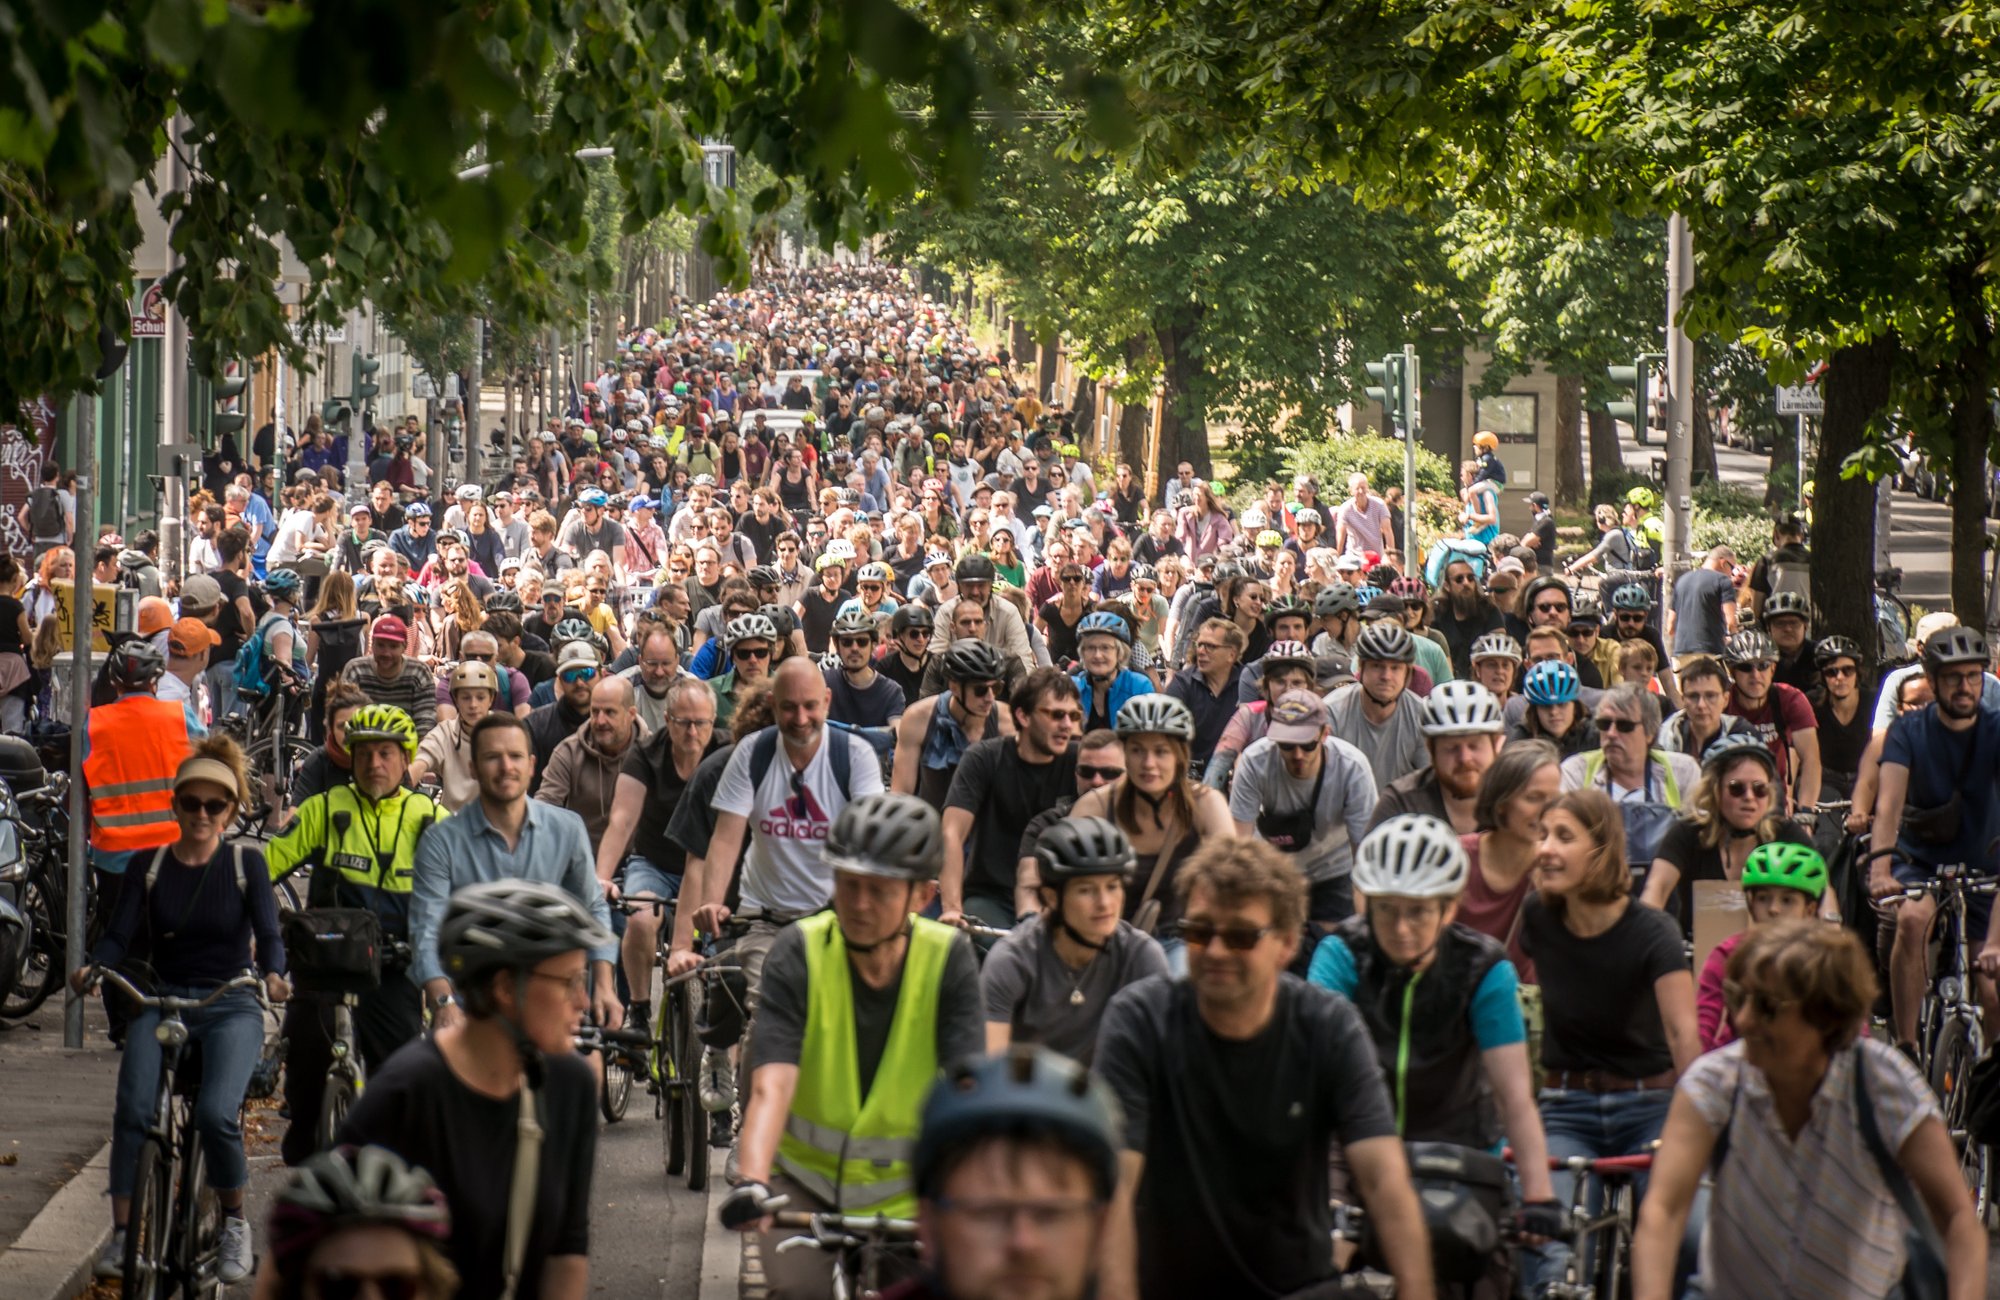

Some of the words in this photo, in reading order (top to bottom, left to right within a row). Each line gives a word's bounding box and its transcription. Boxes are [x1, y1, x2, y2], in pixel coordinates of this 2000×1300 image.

[134, 320, 164, 333] Schul
[1782, 400, 1824, 409] Lärmschut
[760, 815, 829, 839] adida
